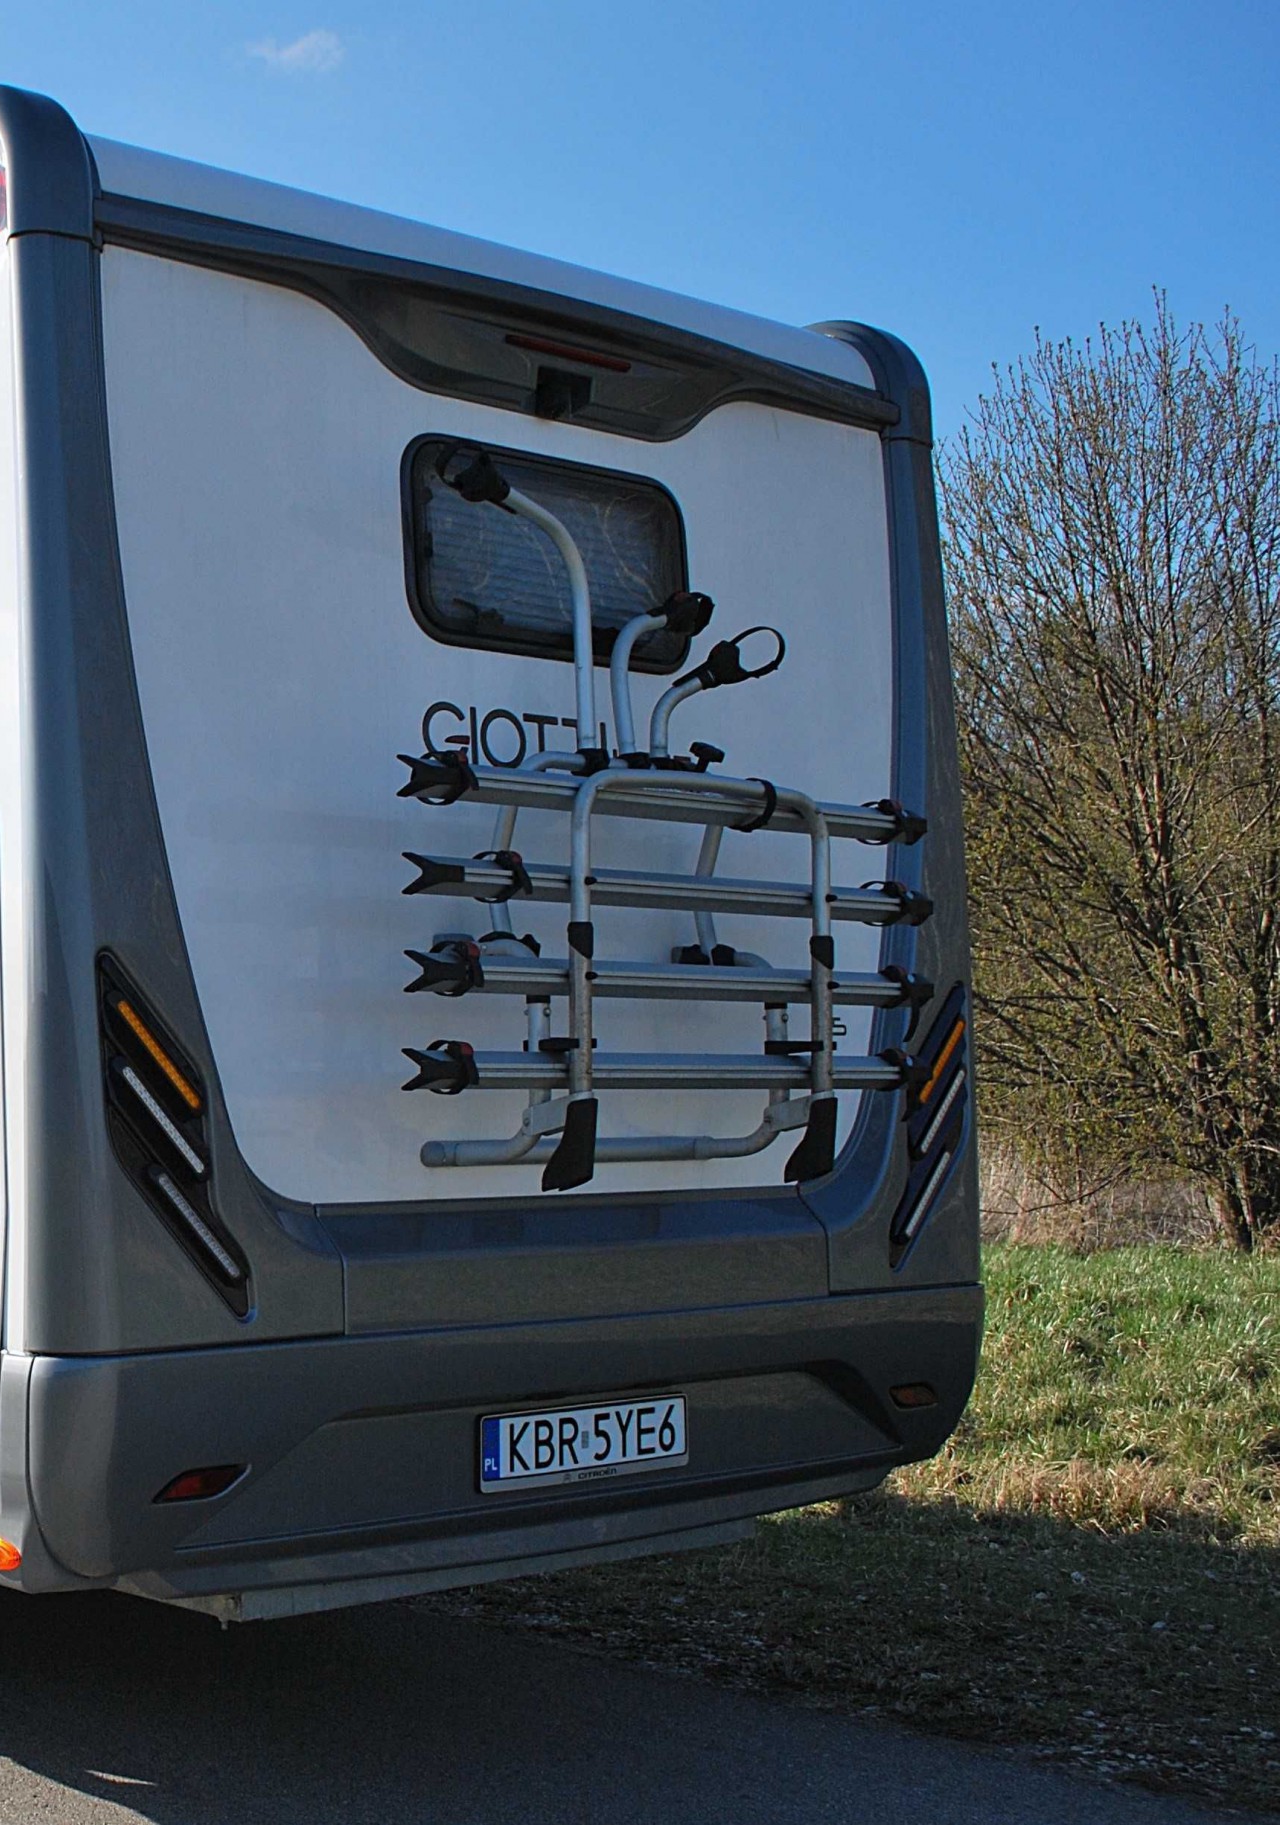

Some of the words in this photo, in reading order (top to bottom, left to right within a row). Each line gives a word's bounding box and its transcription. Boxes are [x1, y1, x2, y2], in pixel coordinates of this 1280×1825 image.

[509, 1417, 579, 1472] KBR
[593, 1404, 676, 1461] 5YE6
[484, 1458, 498, 1471] PL
